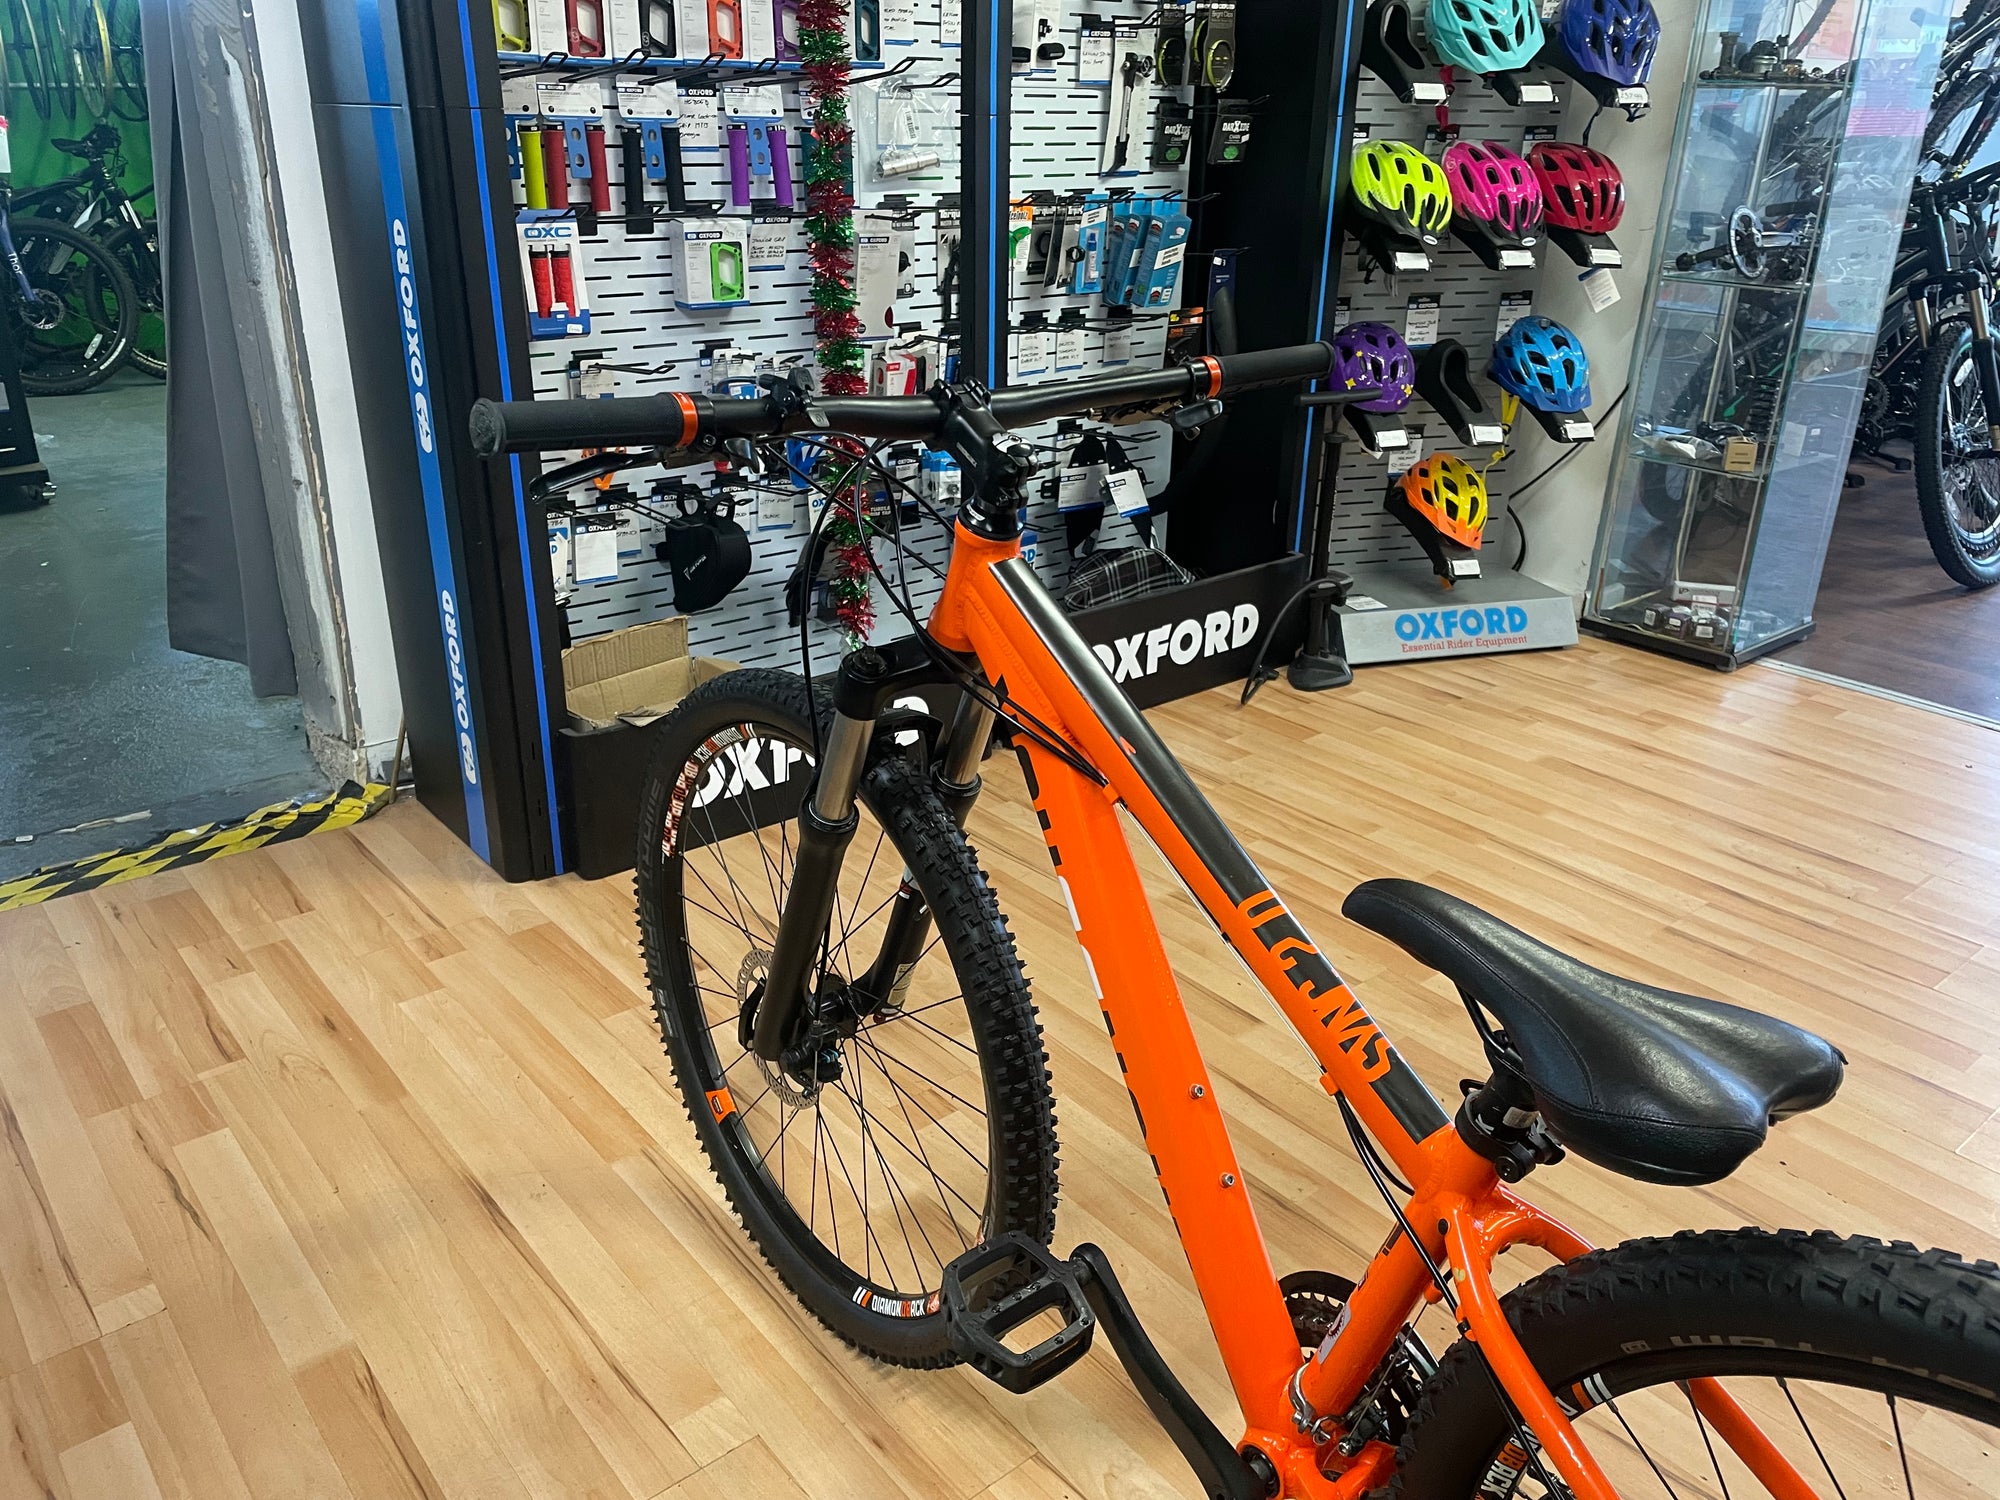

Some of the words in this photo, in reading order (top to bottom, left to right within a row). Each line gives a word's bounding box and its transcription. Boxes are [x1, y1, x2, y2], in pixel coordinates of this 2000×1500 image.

[940, 210, 960, 219] Torqu
[524, 227, 572, 238] OXC
[8, 250, 22, 274] Thor
[393, 219, 424, 388] OXFORD
[1395, 606, 1528, 641] OXFORD
[1402, 640, 1445, 653] Essential
[1447, 637, 1473, 650] Rider
[1475, 635, 1528, 649] Equipment
[442, 590, 469, 730] OXFORD
[871, 1294, 925, 1317] DIAMONDBACK
